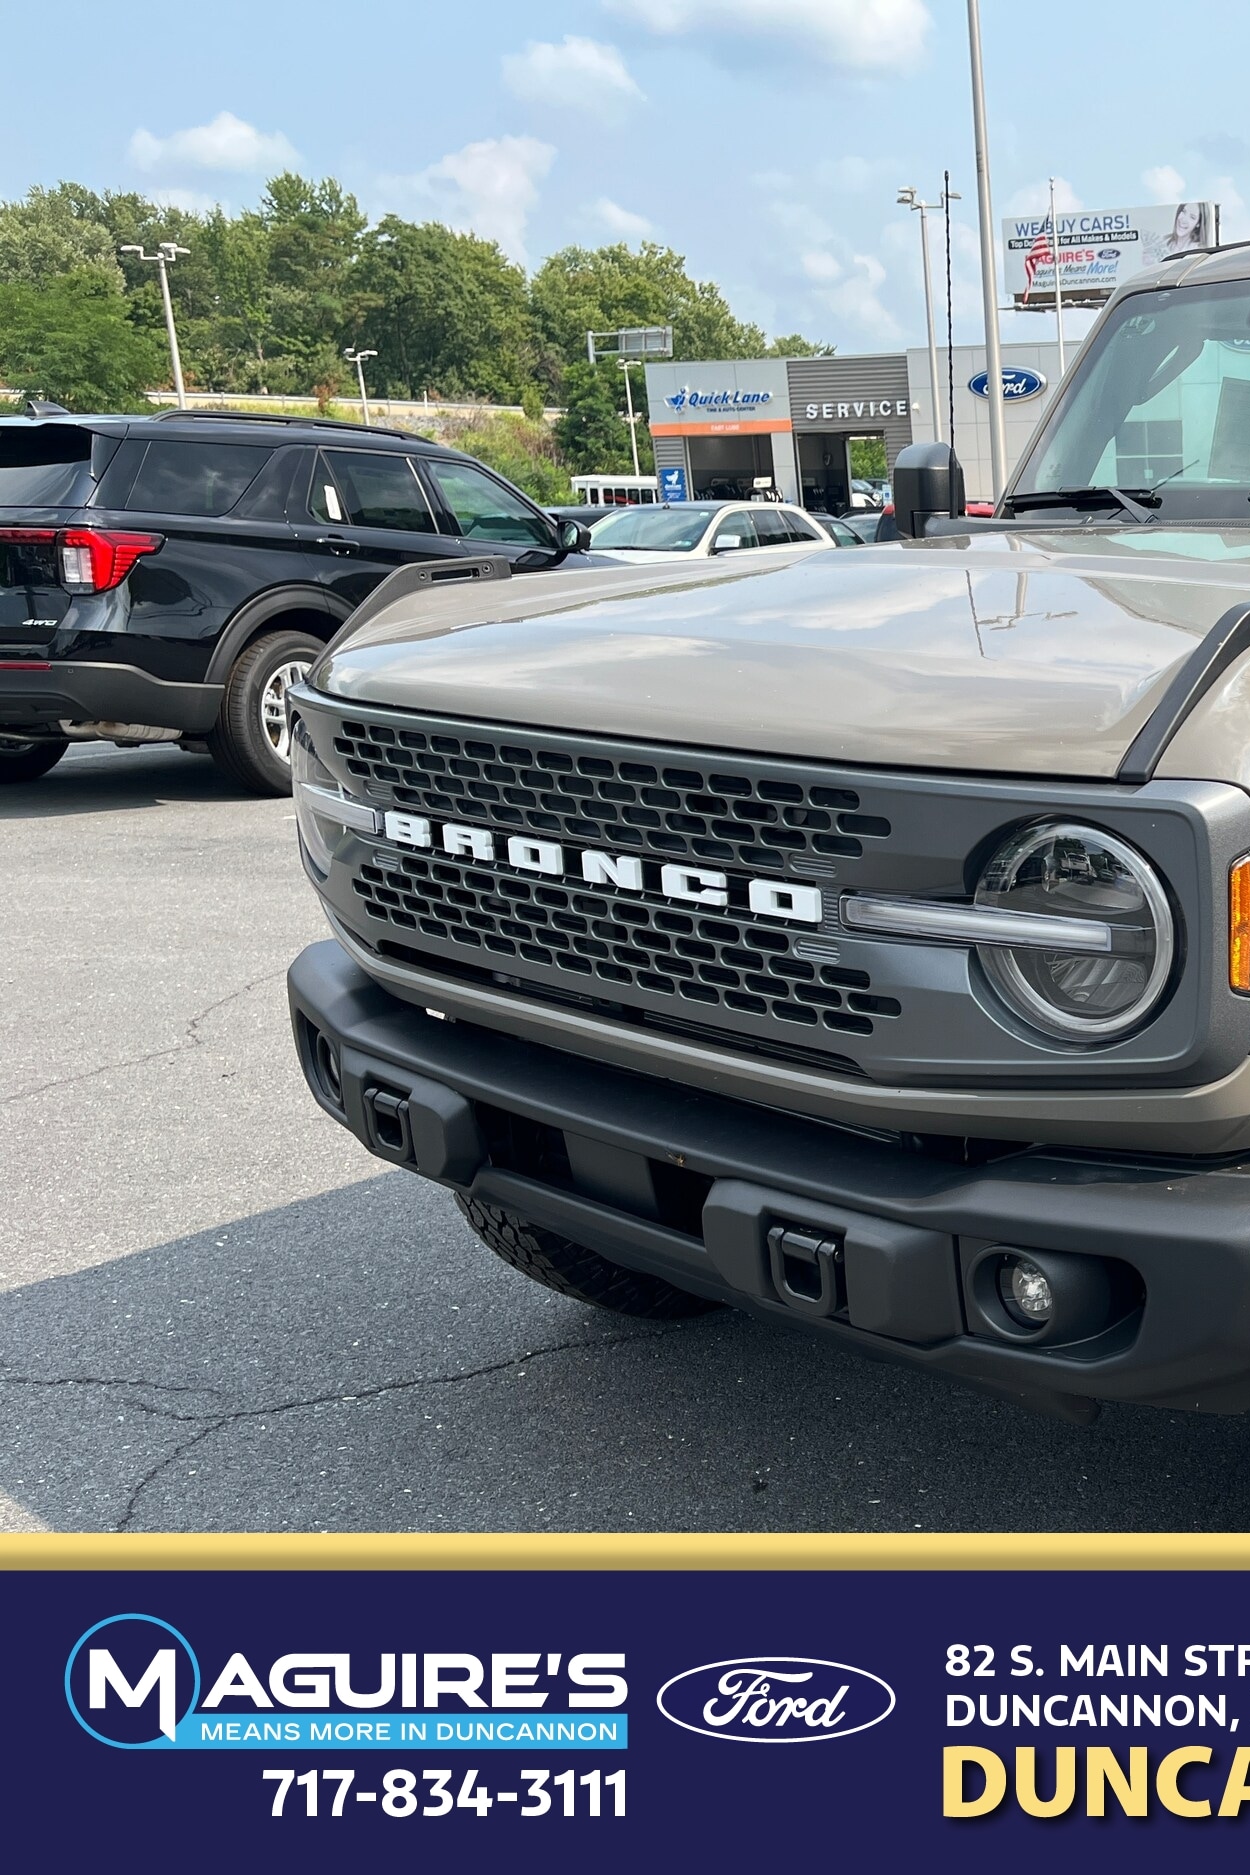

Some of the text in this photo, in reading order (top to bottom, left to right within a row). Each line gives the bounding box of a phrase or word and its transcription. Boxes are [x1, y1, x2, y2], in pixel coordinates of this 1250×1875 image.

[1015, 215, 1130, 236] WE BUY CARS!
[1011, 240, 1023, 249] Top
[1061, 235, 1070, 245] for
[1071, 235, 1081, 243] All
[1082, 232, 1104, 243] Makes
[1104, 233, 1110, 241] &
[1111, 231, 1137, 241] Models
[1063, 263, 1086, 274] Means
[1086, 261, 1119, 275] More!
[688, 390, 770, 408] Quick Lane
[806, 400, 908, 420] SERVICE
[22, 618, 58, 626] 4WD
[384, 810, 823, 923] BRONCO
